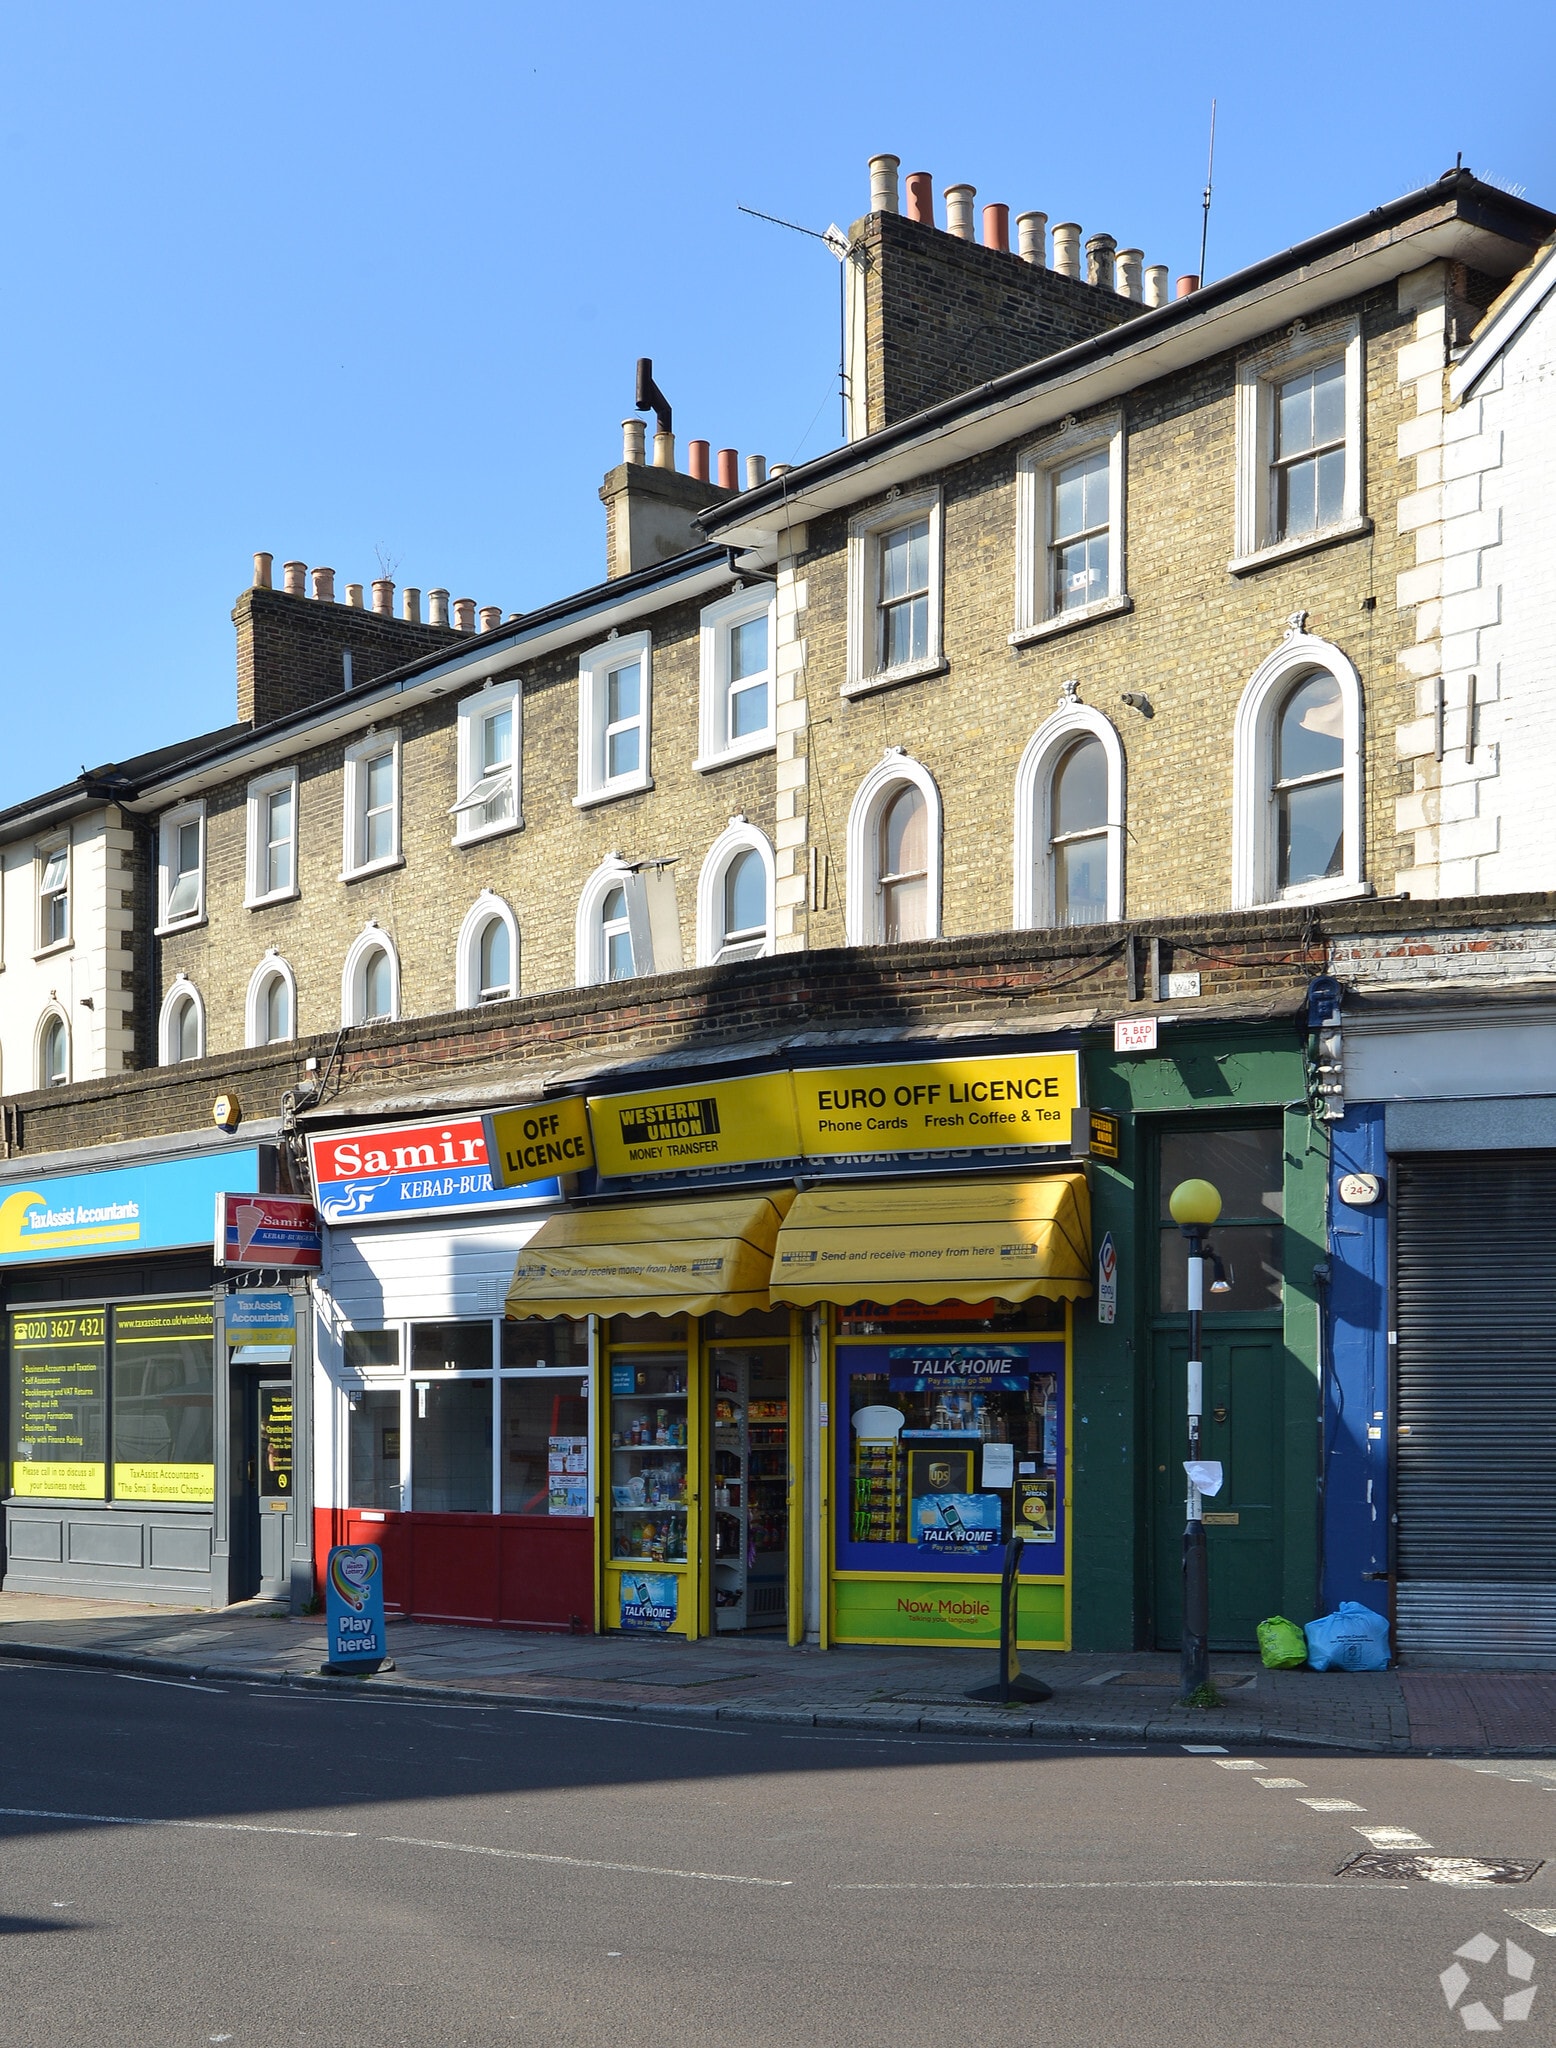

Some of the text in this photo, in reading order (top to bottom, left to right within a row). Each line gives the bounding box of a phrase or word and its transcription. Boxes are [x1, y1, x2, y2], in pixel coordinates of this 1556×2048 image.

[1122, 1026, 1152, 1036] 2 BED
[1126, 1035, 1147, 1044] FLAT
[818, 1077, 1059, 1110] EURO OFF LICENCE
[620, 1102, 700, 1126] WESTERN
[819, 1109, 1061, 1132] Phone Cards Fresh Coffee & Tea
[523, 1114, 559, 1140] OFF
[647, 1120, 702, 1140] UNION
[506, 1136, 585, 1172] LICENCE
[629, 1140, 719, 1160] MONEY TRANSFER
[1350, 1186, 1374, 1195] 24-7
[29, 1200, 138, 1229] TaxAssist Accountants
[264, 1215, 315, 1228] Samir's
[821, 1247, 995, 1260] Send and receive money from here
[550, 1267, 571, 1276] Send
[571, 1267, 588, 1276] and
[589, 1266, 616, 1276] receive
[618, 1266, 645, 1275] money
[646, 1264, 666, 1273] from
[668, 1264, 687, 1273] here
[237, 1300, 282, 1310] TaxAssist
[232, 1313, 289, 1322] Accountants
[28, 1318, 104, 1339] 020 3627 4321
[912, 1360, 1012, 1374] TALK HOME
[928, 1378, 941, 1386] Pay
[22, 1466, 39, 1476] Please
[41, 1467, 50, 1475] call
[67, 1468, 87, 1476] discuss
[130, 1468, 158, 1478] TaxAssist
[160, 1469, 199, 1479] Accountants
[931, 1470, 948, 1484] ups
[30, 1481, 87, 1494] your business needs.
[152, 1484, 178, 1494] Business
[924, 1530, 993, 1541] TALK HOME
[625, 1607, 671, 1618] TALK HOME
[898, 1598, 989, 1615] Now Mobile
[340, 1617, 371, 1634] Play
[337, 1635, 376, 1652] here!
